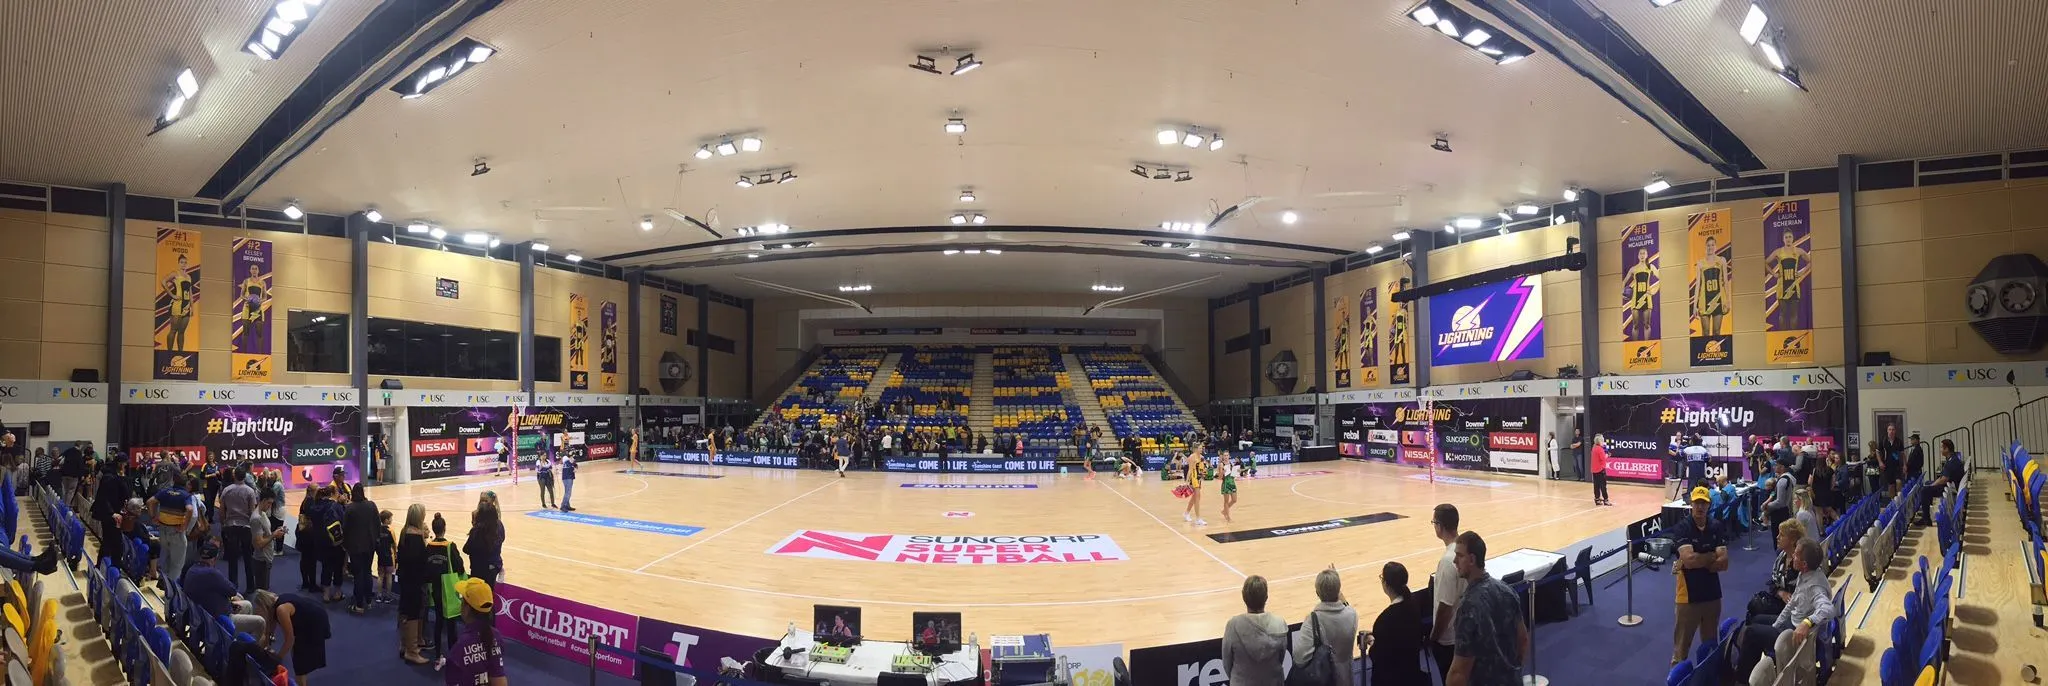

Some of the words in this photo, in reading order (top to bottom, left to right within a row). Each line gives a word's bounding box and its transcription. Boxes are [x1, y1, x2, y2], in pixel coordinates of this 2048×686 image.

[1777, 202, 1798, 213] #10
[1704, 212, 1717, 223] #9
[1773, 220, 1802, 228] SCHERIAN
[1634, 225, 1647, 234] #8
[174, 231, 187, 241] #1
[1630, 233, 1652, 241] MADELINE
[248, 241, 260, 250] #2
[1706, 280, 1718, 292] GD
[1438, 327, 1494, 345] LIGHTNING
[1773, 348, 1808, 356] LIGHTNING
[161, 366, 193, 374] LIGHTNING
[238, 369, 268, 377] LIGHTNING
[1967, 368, 1997, 380] USC
[1740, 375, 1763, 385] USC
[1808, 373, 1833, 384] USC
[1883, 370, 1911, 382] USC
[1610, 380, 1630, 390] USC
[1668, 378, 1690, 388] USC
[0, 386, 18, 397] SC
[71, 388, 97, 398] USC
[145, 389, 169, 399] USC
[1468, 387, 1481, 395] USC
[1513, 385, 1528, 393] USC
[213, 390, 235, 400] USC
[278, 391, 297, 400] USC
[334, 392, 352, 401] USC
[519, 414, 563, 426] LIGHTNING
[206, 418, 293, 436] #LightItUp
[1343, 430, 1360, 440] rebel
[1445, 435, 1469, 443] SUNCORP
[1493, 436, 1534, 446] NISSAN
[1615, 440, 1657, 450] HOSTPLUS
[296, 448, 334, 457] SUNCORP
[415, 442, 455, 453] NISSAN
[590, 446, 614, 455] NISSAN
[683, 453, 699, 461] COME
[701, 454, 709, 462] TO
[1255, 453, 1269, 463] OME
[1270, 453, 1278, 461] TO
[1280, 452, 1291, 461] LIFE
[1404, 450, 1430, 459] NISSA
[1454, 455, 1482, 463] HOSTPLUS
[753, 456, 770, 465] COME
[773, 457, 781, 465] TO
[783, 457, 797, 466] LIFE
[919, 461, 938, 470] COME
[953, 461, 968, 470] LIFE
[1005, 461, 1024, 470] COME
[1028, 461, 1037, 470] TO
[1039, 461, 1055, 470] LIFE
[1613, 459, 1659, 472] GILBERT
[1271, 522, 1341, 536] Downer
[908, 535, 1101, 544] SUNCORP
[903, 544, 1054, 553] SUPER
[895, 551, 1119, 564] NETBALL
[520, 601, 628, 649] GILBERT
[463, 652, 487, 665] EVENT
